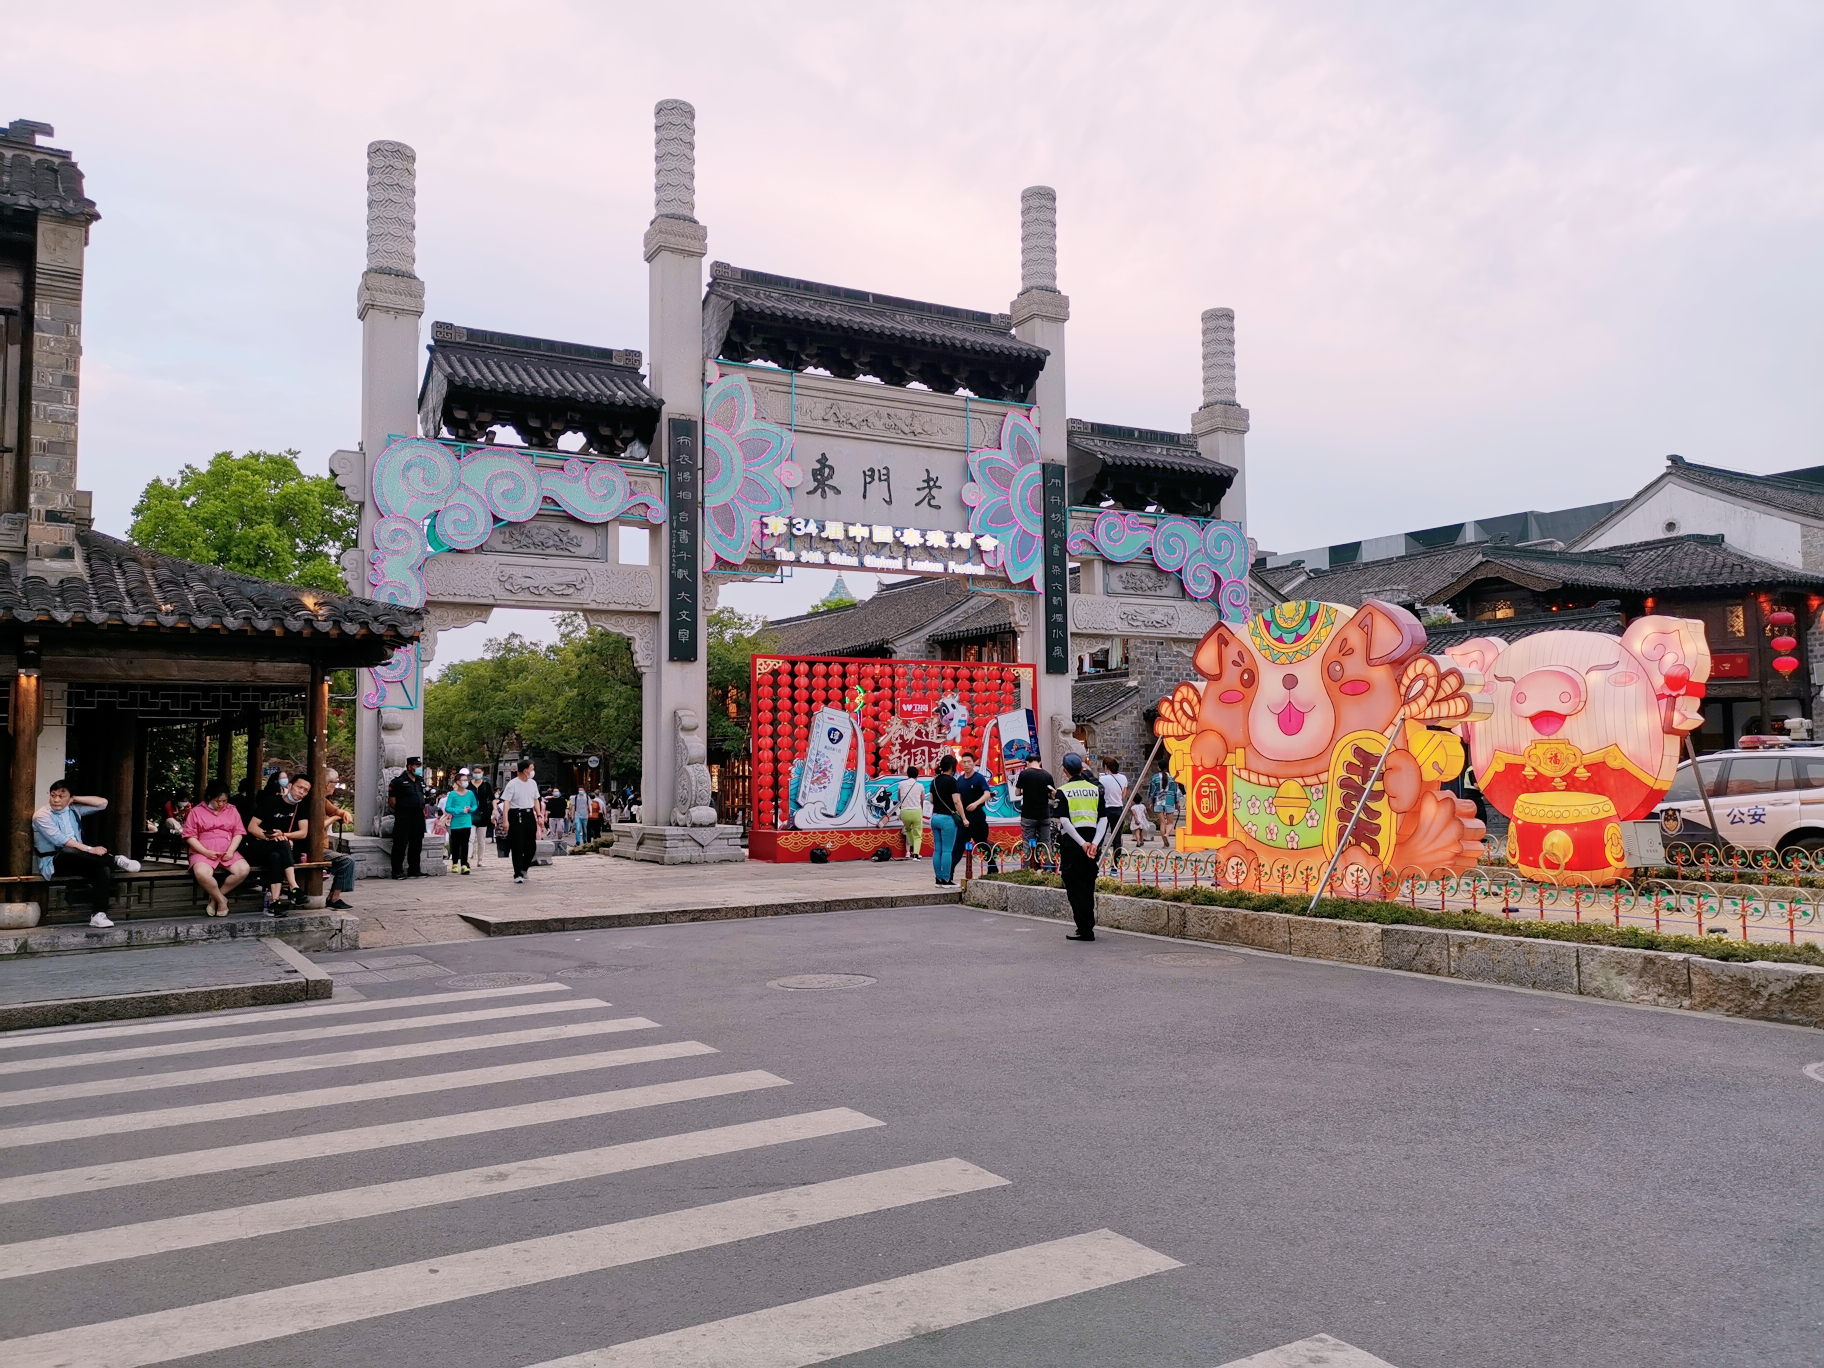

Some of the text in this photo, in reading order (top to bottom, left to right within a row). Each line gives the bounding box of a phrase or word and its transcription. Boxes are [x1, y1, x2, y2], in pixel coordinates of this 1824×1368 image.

[774, 547, 795, 561] The
[800, 550, 825, 564] 34th
[829, 551, 859, 567] China
[907, 557, 944, 573] Lantern
[948, 560, 986, 575] Festival
[878, 716, 946, 747] 老味道
[1548, 752, 1560, 765] 福
[1727, 805, 1766, 825] 公安
